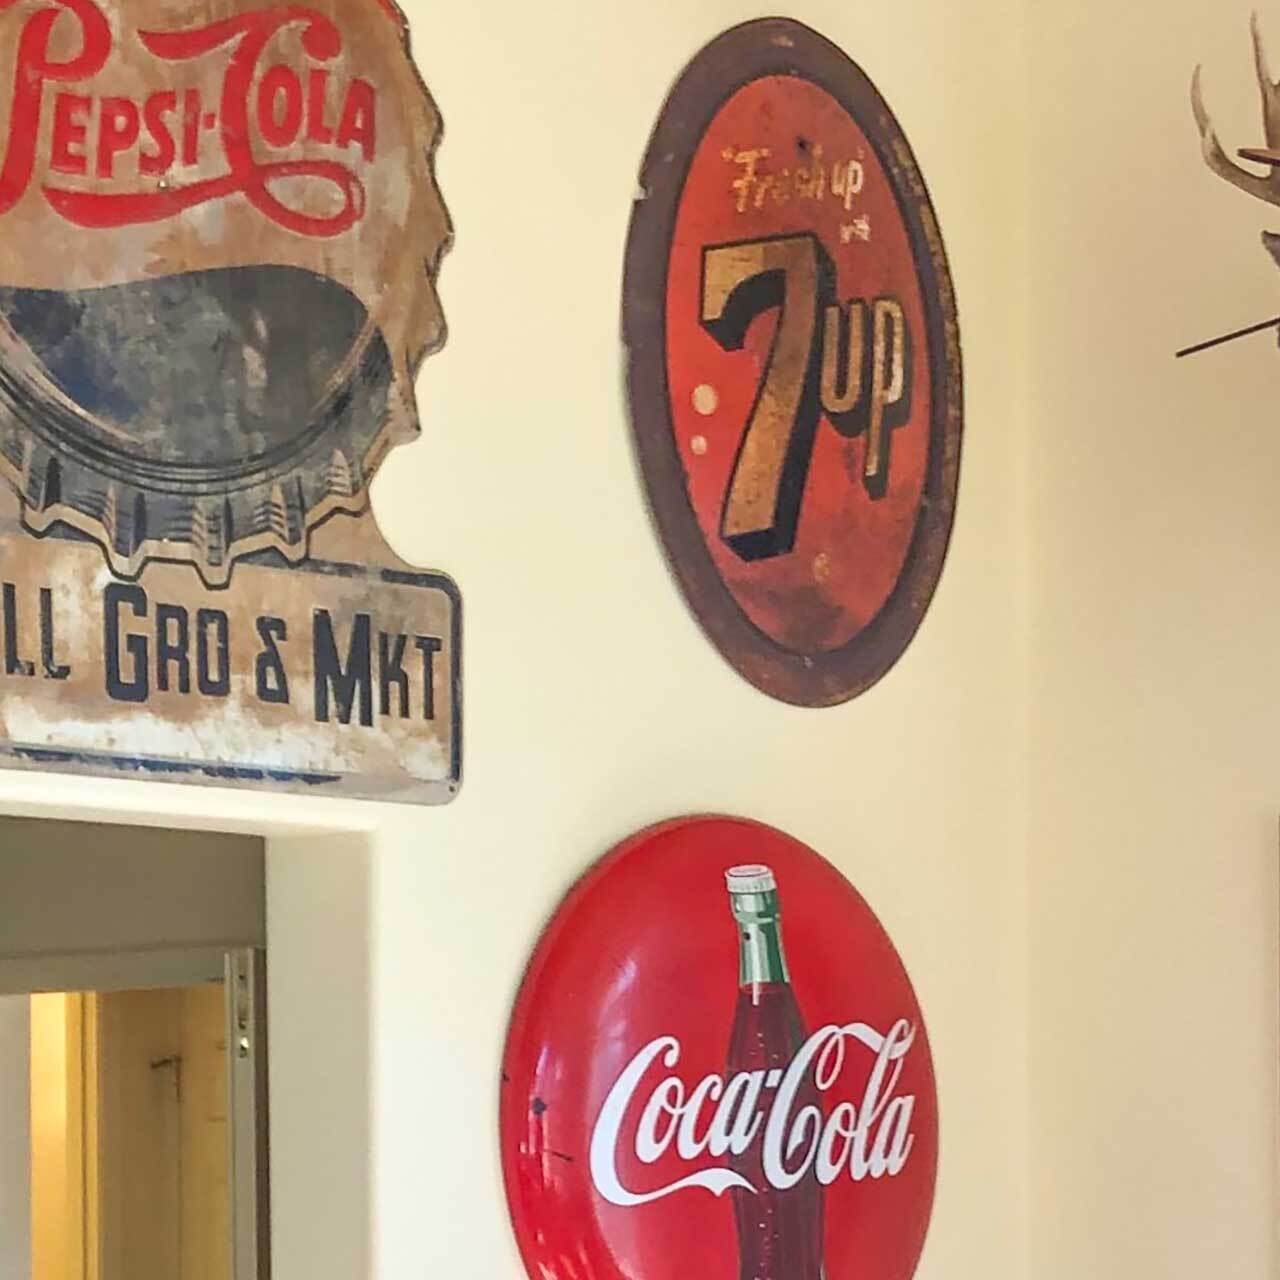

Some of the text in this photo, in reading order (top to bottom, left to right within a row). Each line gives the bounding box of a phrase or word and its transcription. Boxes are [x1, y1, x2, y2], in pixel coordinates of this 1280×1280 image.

[104, 580, 231, 703] GRO
[314, 608, 443, 727] MKT
[589, 1018, 915, 1206] Coca-Cola
